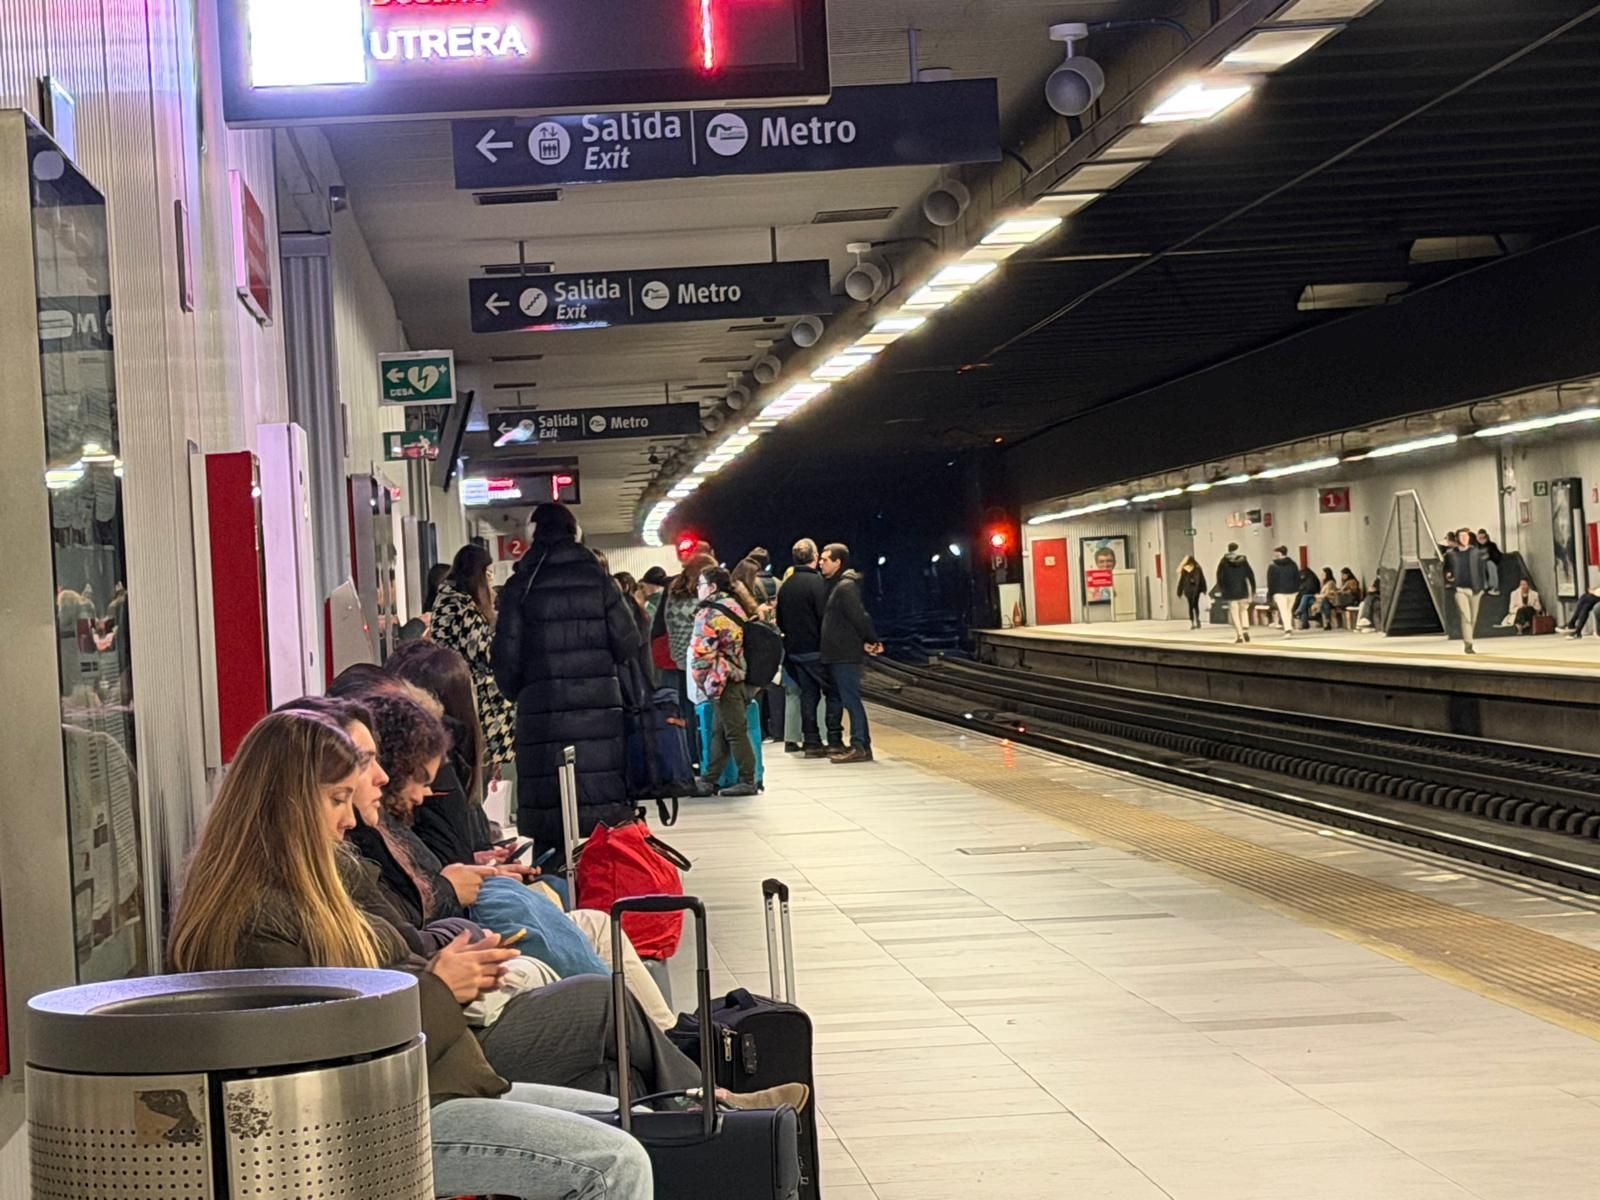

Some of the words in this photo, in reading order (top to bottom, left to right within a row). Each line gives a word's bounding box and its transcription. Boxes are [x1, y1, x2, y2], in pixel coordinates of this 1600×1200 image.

[370, 25, 528, 60] UTRERA
[582, 112, 682, 143] Salida
[761, 117, 857, 147] Metro
[584, 145, 631, 170] Exit
[554, 278, 621, 301] Salida
[677, 283, 741, 304] Metro
[556, 303, 588, 320] Exit
[538, 414, 578, 428] Salida
[610, 417, 649, 430] Metro
[539, 428, 558, 439] Exit
[1327, 494, 1336, 507] 1
[511, 540, 521, 554] 2
